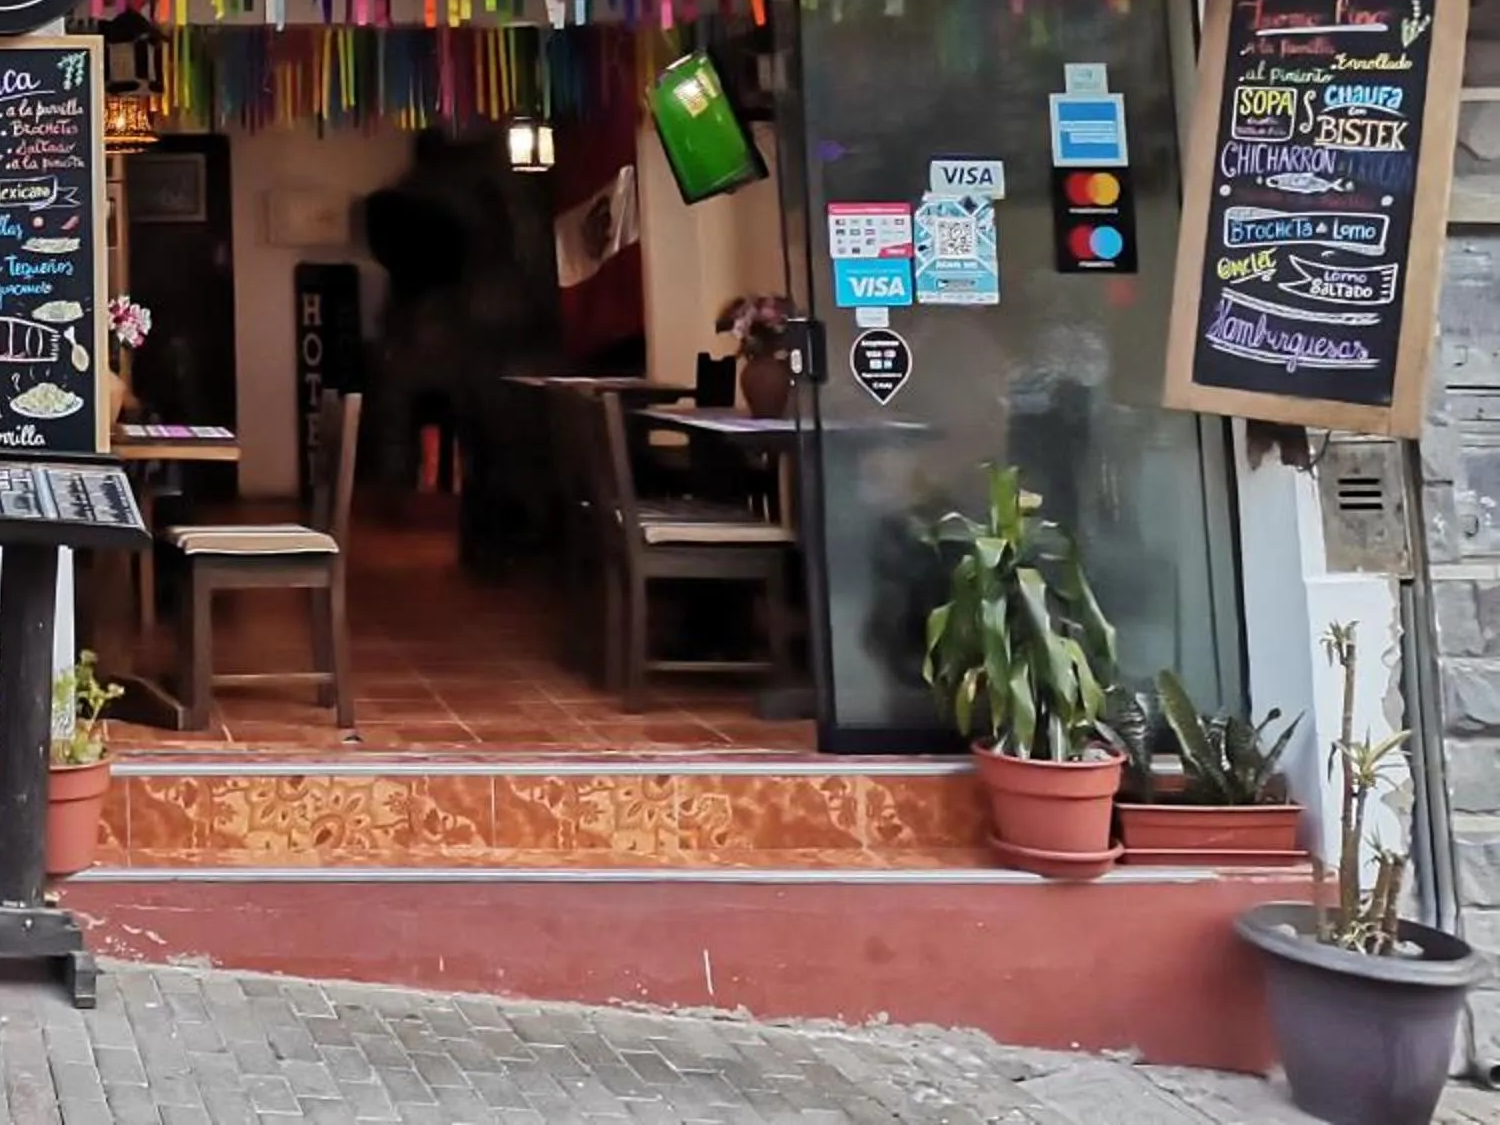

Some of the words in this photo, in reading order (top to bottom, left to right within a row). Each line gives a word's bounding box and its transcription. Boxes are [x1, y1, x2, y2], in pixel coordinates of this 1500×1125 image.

[1239, 90, 1294, 116] SOPA
[1314, 115, 1409, 151] BISTEK
[1221, 140, 1337, 178] CHICHARRON
[941, 167, 994, 185] VISA
[848, 276, 906, 298] VISA
